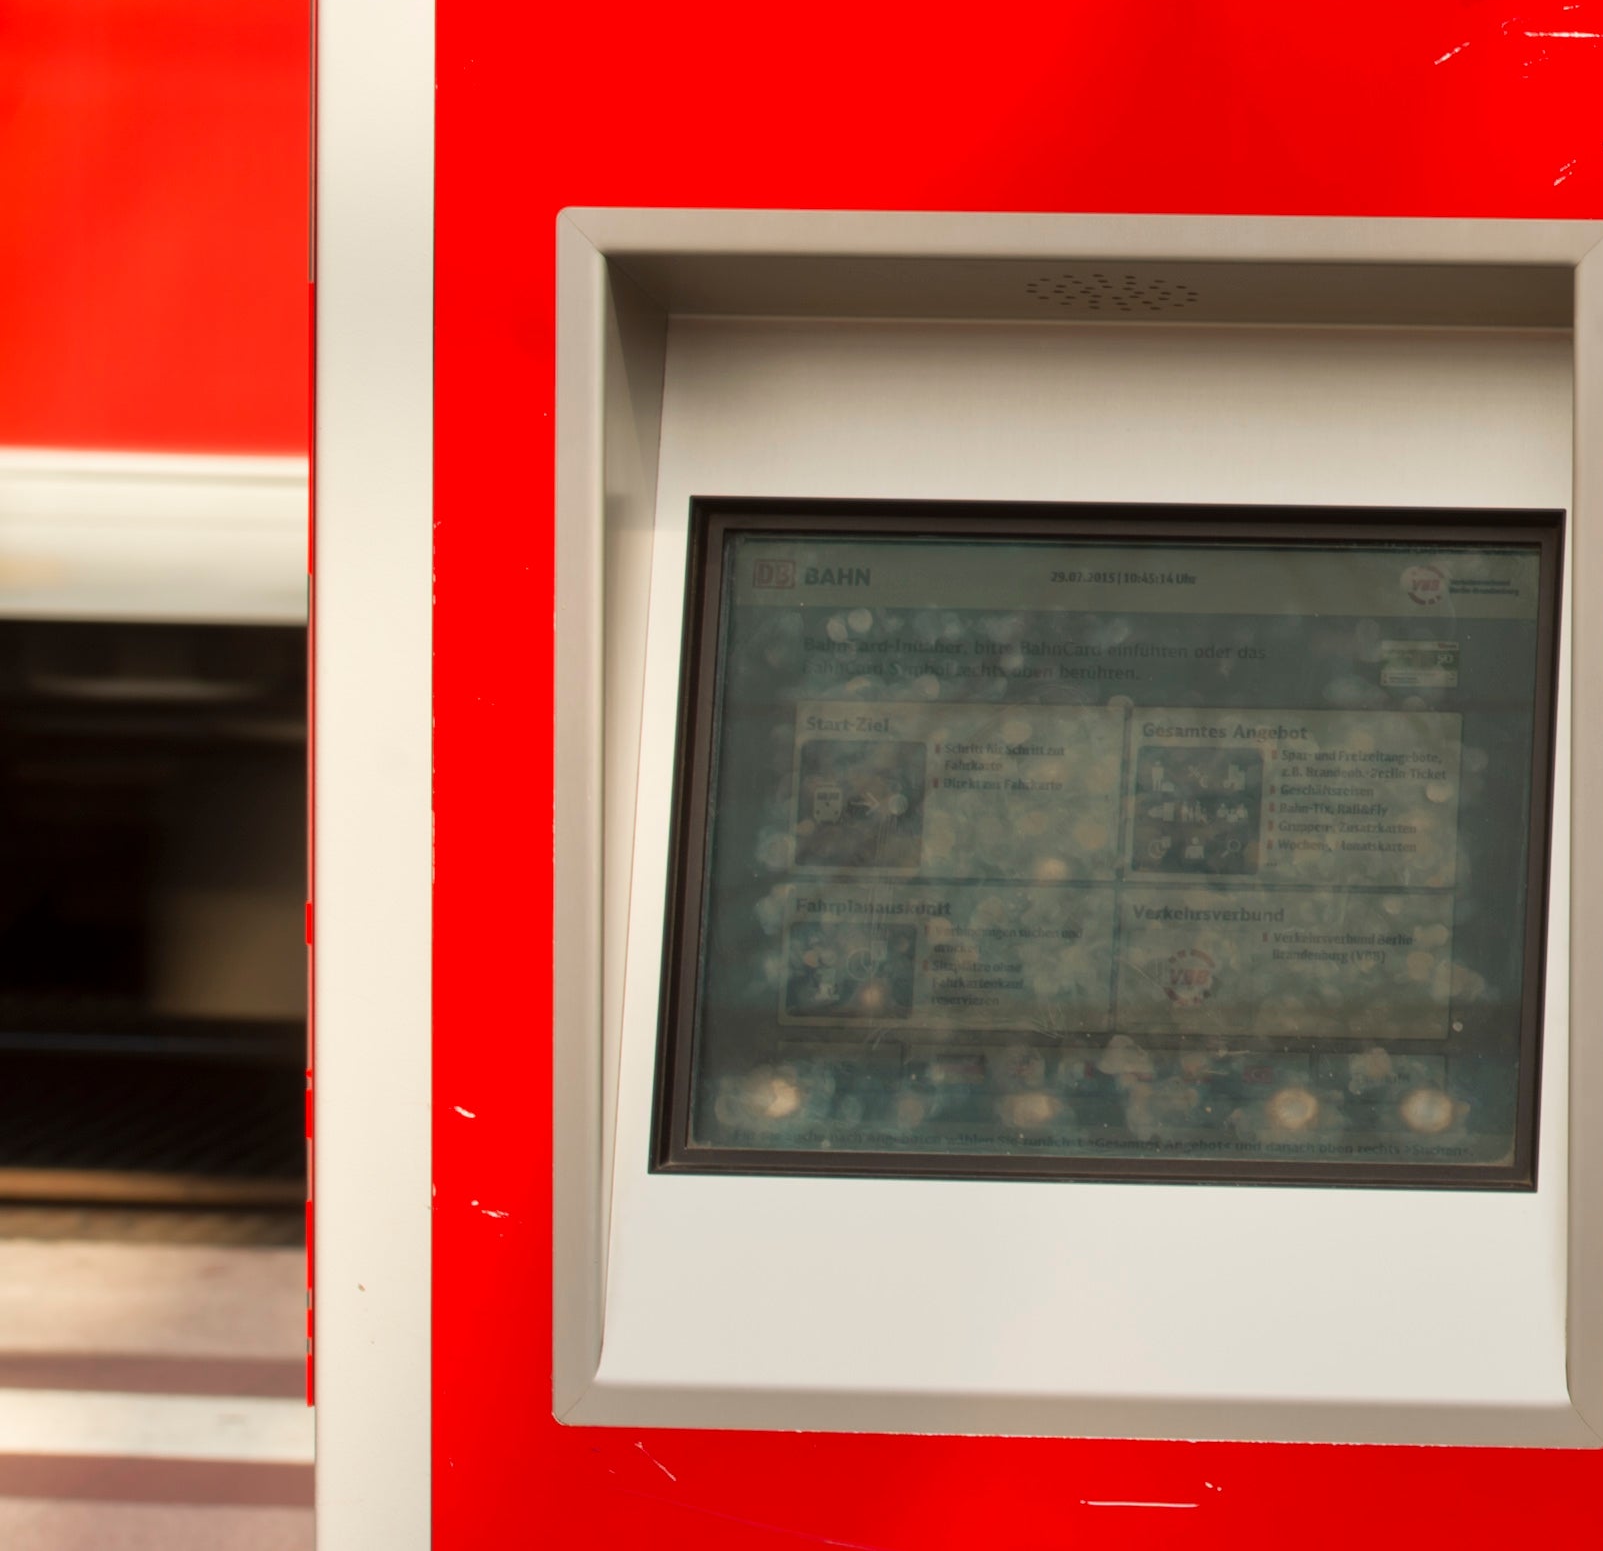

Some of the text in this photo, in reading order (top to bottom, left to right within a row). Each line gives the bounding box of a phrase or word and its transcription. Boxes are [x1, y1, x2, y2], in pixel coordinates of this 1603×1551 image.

[804, 568, 870, 586] BAHN
[1194, 644, 1232, 659] oder
[1238, 644, 1266, 660] das
[806, 716, 889, 732] Start-Ziel
[1142, 722, 1308, 743] Gesamtes Angebot
[1133, 906, 1285, 922] Verkehrsverbund
